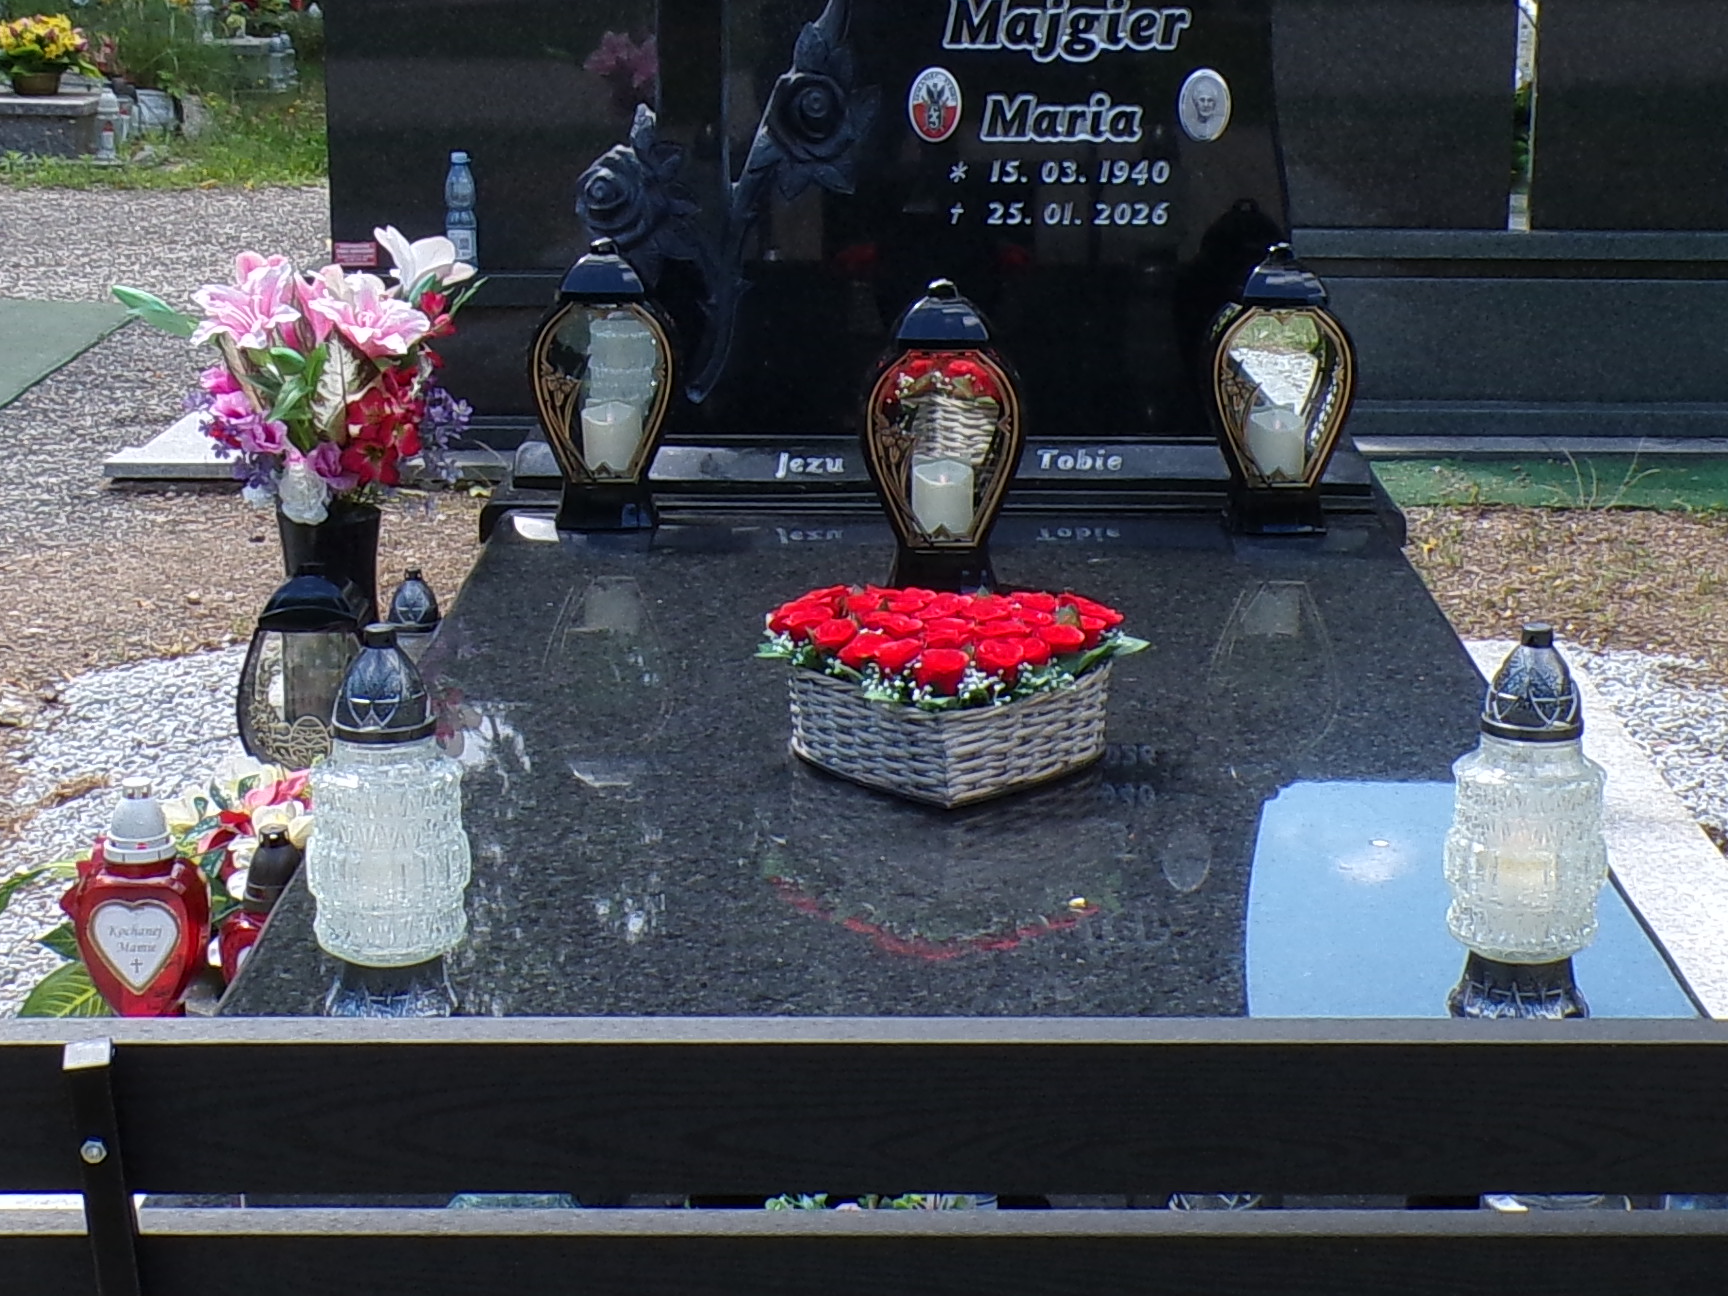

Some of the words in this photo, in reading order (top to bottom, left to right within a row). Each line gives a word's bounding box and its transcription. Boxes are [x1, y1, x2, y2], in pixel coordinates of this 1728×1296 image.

[980, 92, 1143, 142] Maria
[990, 159, 1028, 183] 15.
[1041, 159, 1087, 184] 03.
[1099, 159, 1170, 186] 1940
[987, 202, 1033, 225] 25.
[1044, 202, 1083, 225] 01.
[1094, 202, 1170, 225] 2026
[775, 452, 844, 478] Jezu
[1036, 449, 1123, 471] Tobie
[108, 925, 163, 940] Kochanej
[116, 941, 157, 953] Mamie
